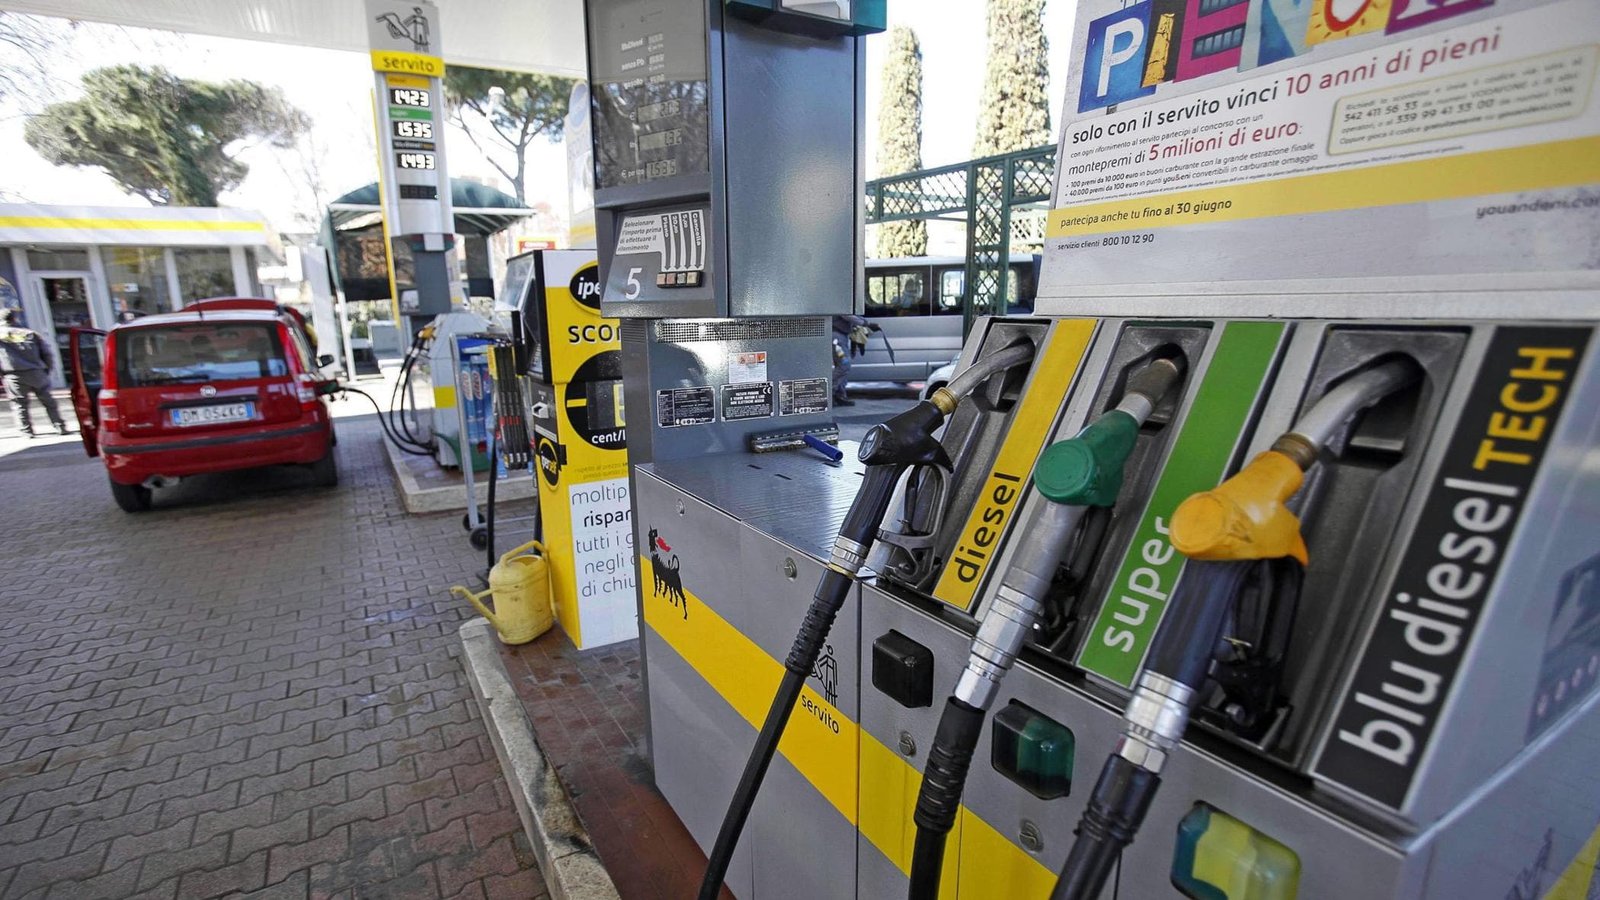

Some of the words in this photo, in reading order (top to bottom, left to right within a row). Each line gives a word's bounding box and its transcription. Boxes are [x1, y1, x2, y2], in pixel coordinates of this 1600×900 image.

[383, 56, 435, 73] servito
[1072, 125, 1102, 144] solo
[1108, 119, 1137, 135] con
[1142, 111, 1153, 128] il
[1157, 99, 1220, 126] servito
[1227, 80, 1278, 109] vinci
[1286, 73, 1311, 96] 10
[1319, 57, 1377, 89] anni
[1385, 48, 1412, 75] di
[1419, 26, 1502, 73] pieni
[1068, 153, 1132, 175] montepremi
[1135, 150, 1146, 164] di
[1149, 143, 1160, 161] 5
[1162, 131, 1223, 159] milioni
[1228, 127, 1247, 146] di
[1070, 151, 1081, 159] con
[1082, 148, 1094, 157] ogni
[1095, 141, 1131, 154] rifornimento
[1139, 134, 1160, 145] servito
[1161, 128, 1191, 141] partecipi
[1192, 126, 1199, 134] al
[1200, 120, 1234, 132] concorso
[1236, 116, 1250, 125] con
[1252, 114, 1263, 122] un
[1082, 177, 1096, 188] premi
[1146, 167, 1164, 176] buoni
[1164, 161, 1199, 173] carburante
[1200, 160, 1214, 168] con
[1214, 157, 1221, 165] la
[1223, 153, 1248, 166] grande
[1250, 146, 1290, 159] estrazione
[1290, 142, 1315, 153] finale
[1089, 185, 1105, 195] premi
[1105, 183, 1113, 191] da
[1125, 181, 1139, 189] euro
[1192, 165, 1229, 179] convertibili
[1230, 165, 1238, 173] in
[1239, 159, 1280, 172] carburante
[1281, 153, 1318, 166] omaggio
[624, 219, 655, 228] Selezionare
[692, 213, 702, 246] Cancella
[1060, 215, 1099, 229] partecipa
[1100, 211, 1129, 223] anche
[1130, 209, 1140, 220] tu
[1142, 206, 1162, 218] fino
[1164, 204, 1173, 215] al
[1176, 202, 1191, 214] 30
[1193, 199, 1232, 215] giugno
[626, 236, 652, 244] effettuare
[646, 226, 662, 235] prima
[1057, 241, 1080, 250] servizio
[1080, 239, 1100, 249] clienti
[1102, 236, 1119, 247] 800
[1121, 235, 1130, 245] 10
[1132, 234, 1140, 244] 12
[1142, 233, 1155, 244] 90
[618, 244, 649, 252] rifornimento
[625, 267, 643, 300] 5
[1473, 346, 1575, 471] TECH
[571, 483, 628, 506] moltip
[583, 510, 632, 528] rispar
[954, 472, 1021, 583] diesel
[575, 531, 610, 554] tutti
[615, 530, 620, 546] i
[584, 553, 625, 576] negli
[1390, 477, 1521, 656] diesel
[582, 579, 596, 597] di
[801, 694, 840, 734] servito
[1338, 661, 1444, 766] blu
